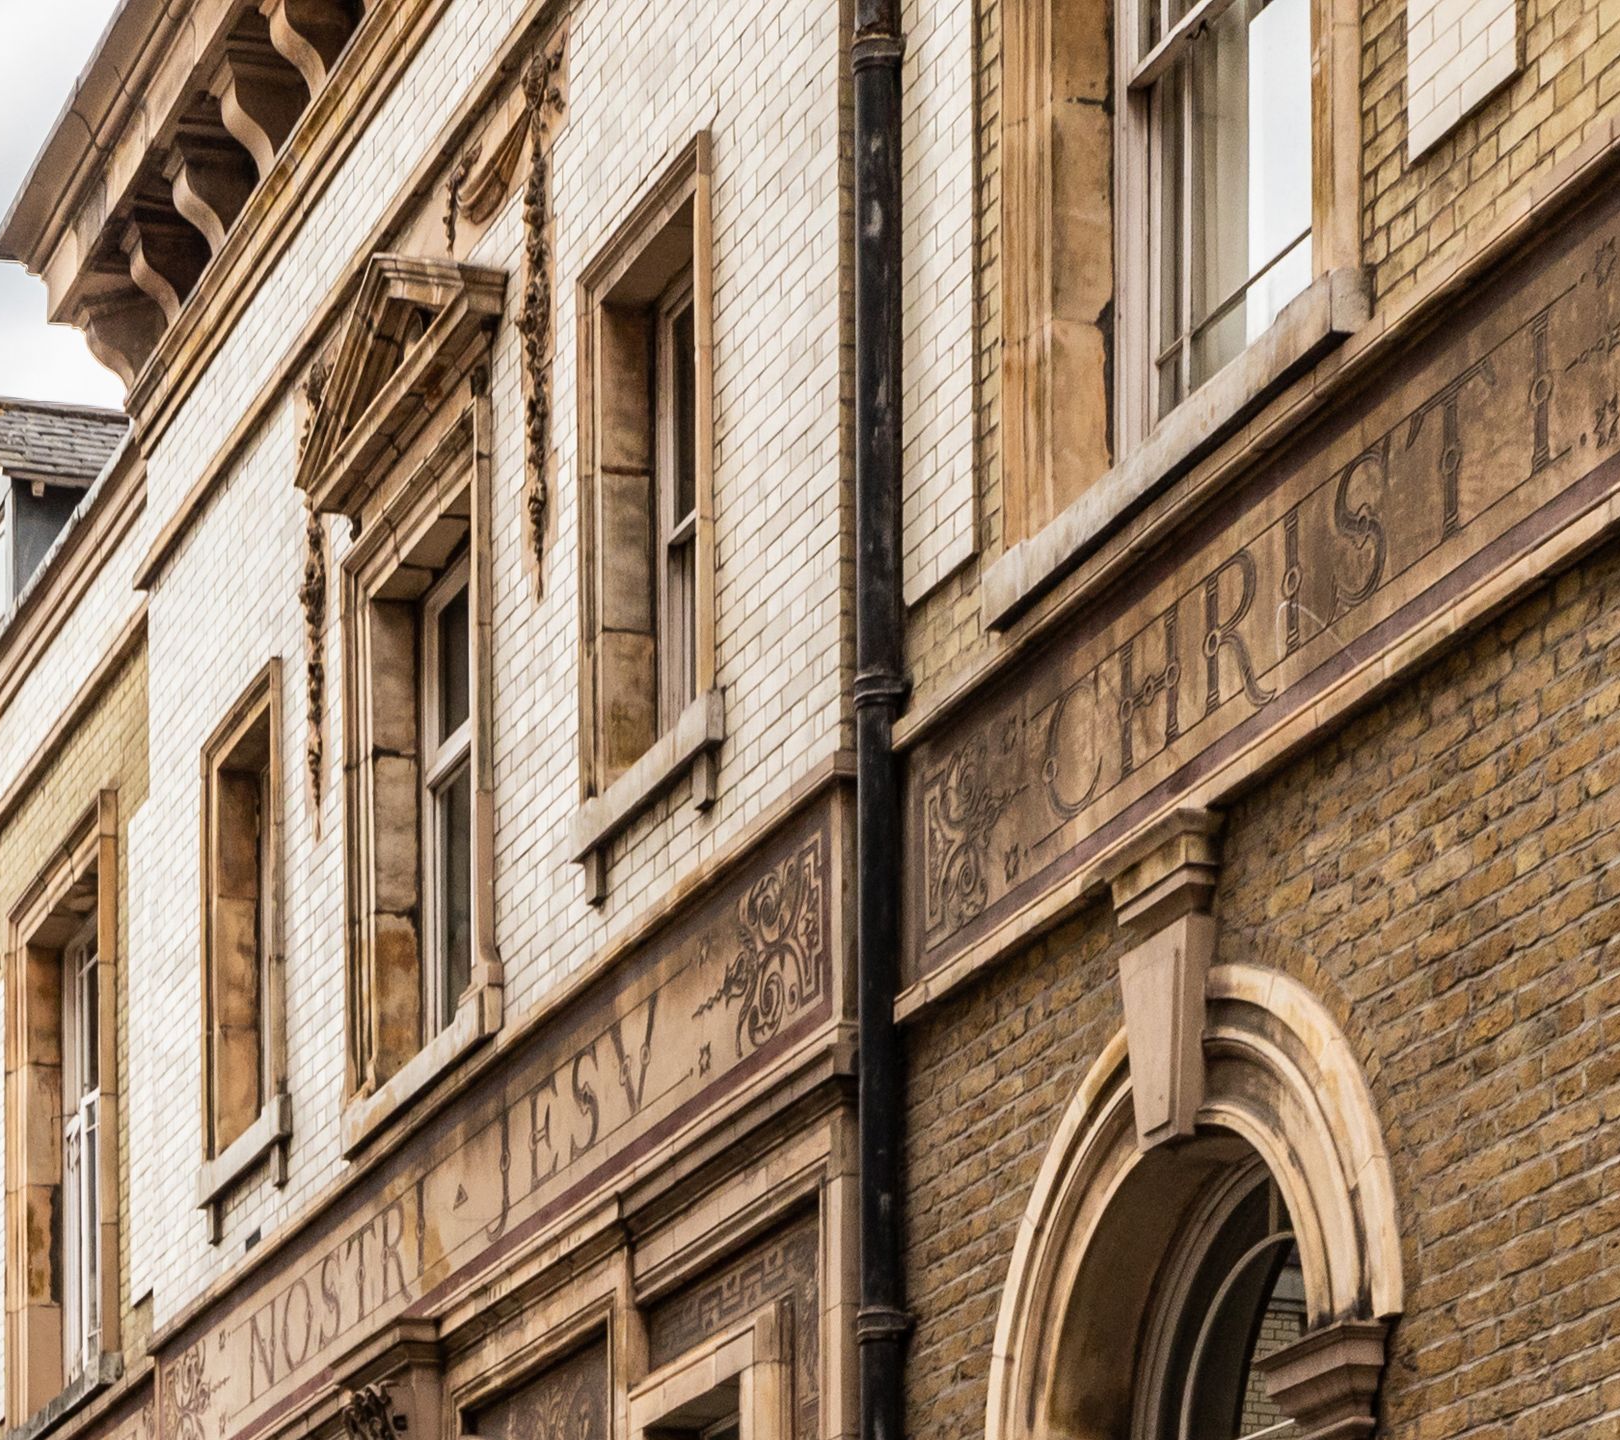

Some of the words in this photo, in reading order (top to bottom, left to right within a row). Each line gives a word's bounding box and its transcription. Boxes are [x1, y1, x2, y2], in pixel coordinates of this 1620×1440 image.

[1041, 310, 1553, 818] CHRISTI
[249, 1180, 425, 1400] NOSTRI
[486, 993, 658, 1242] JESV
